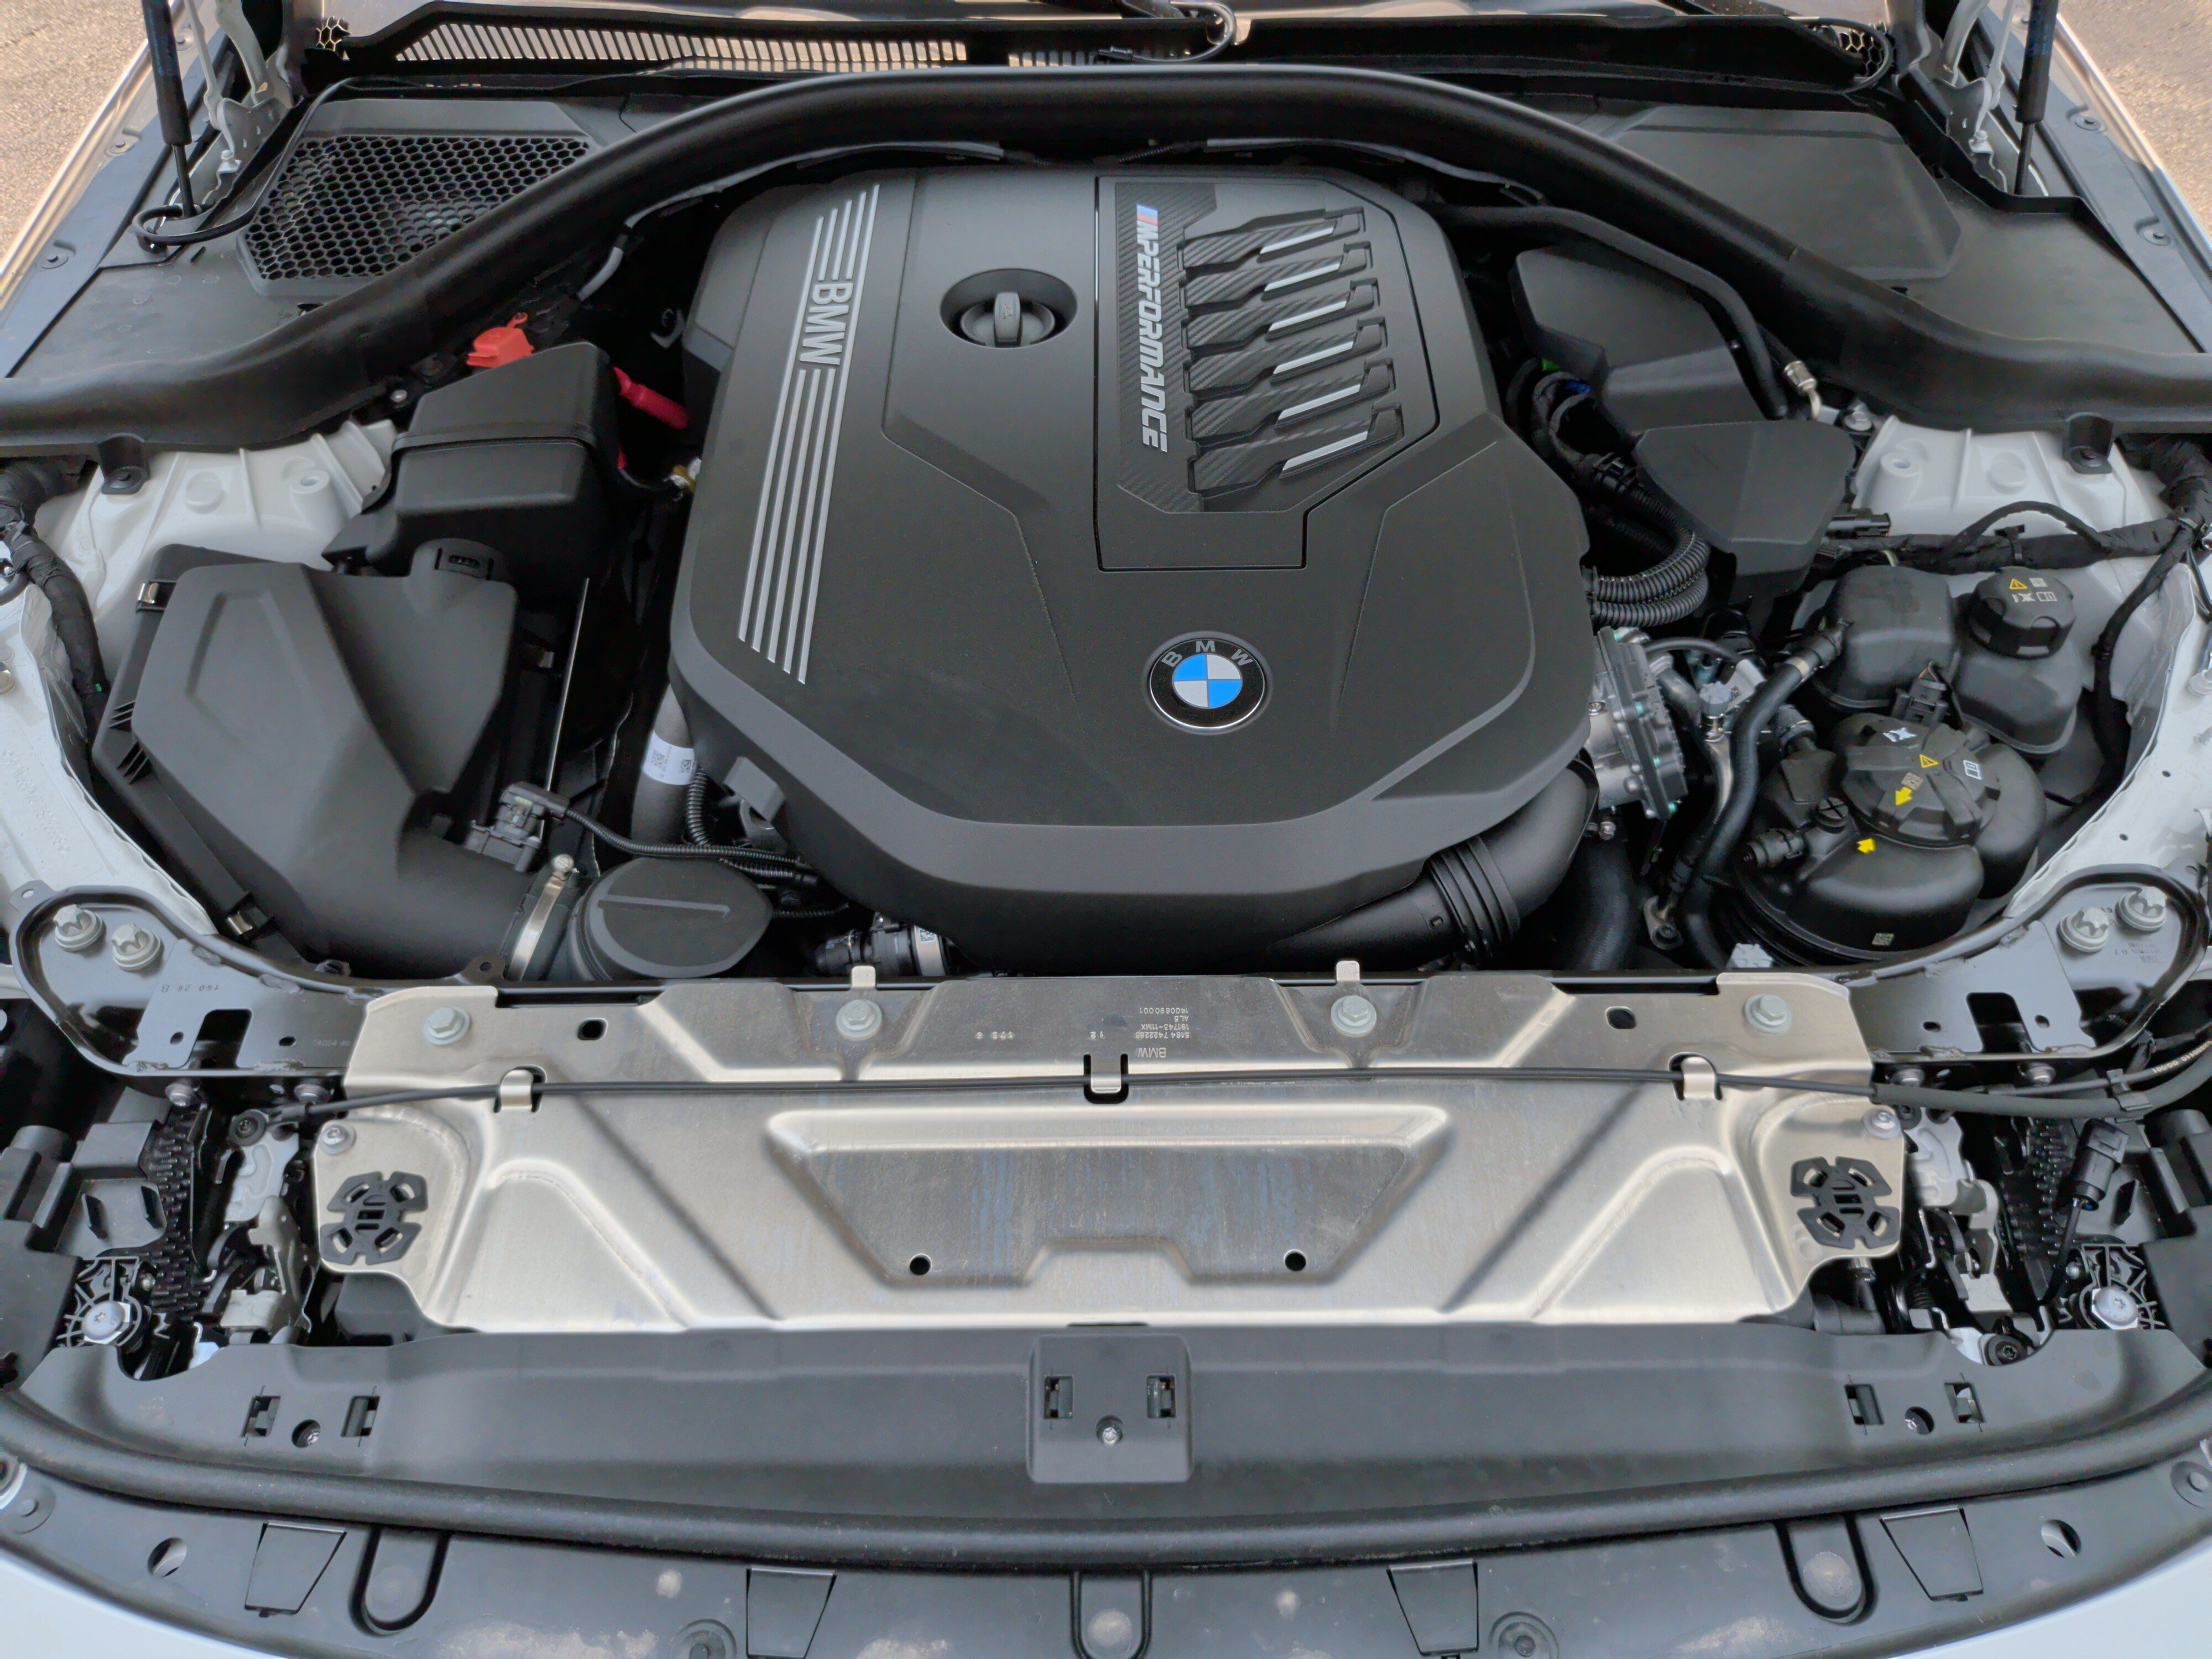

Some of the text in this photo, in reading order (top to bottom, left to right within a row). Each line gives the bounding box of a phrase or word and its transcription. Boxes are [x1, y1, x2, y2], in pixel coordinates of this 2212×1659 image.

[799, 283, 853, 366] BMW
[1161, 640, 1253, 668] BMW
[1138, 1047, 1166, 1058] BMW
